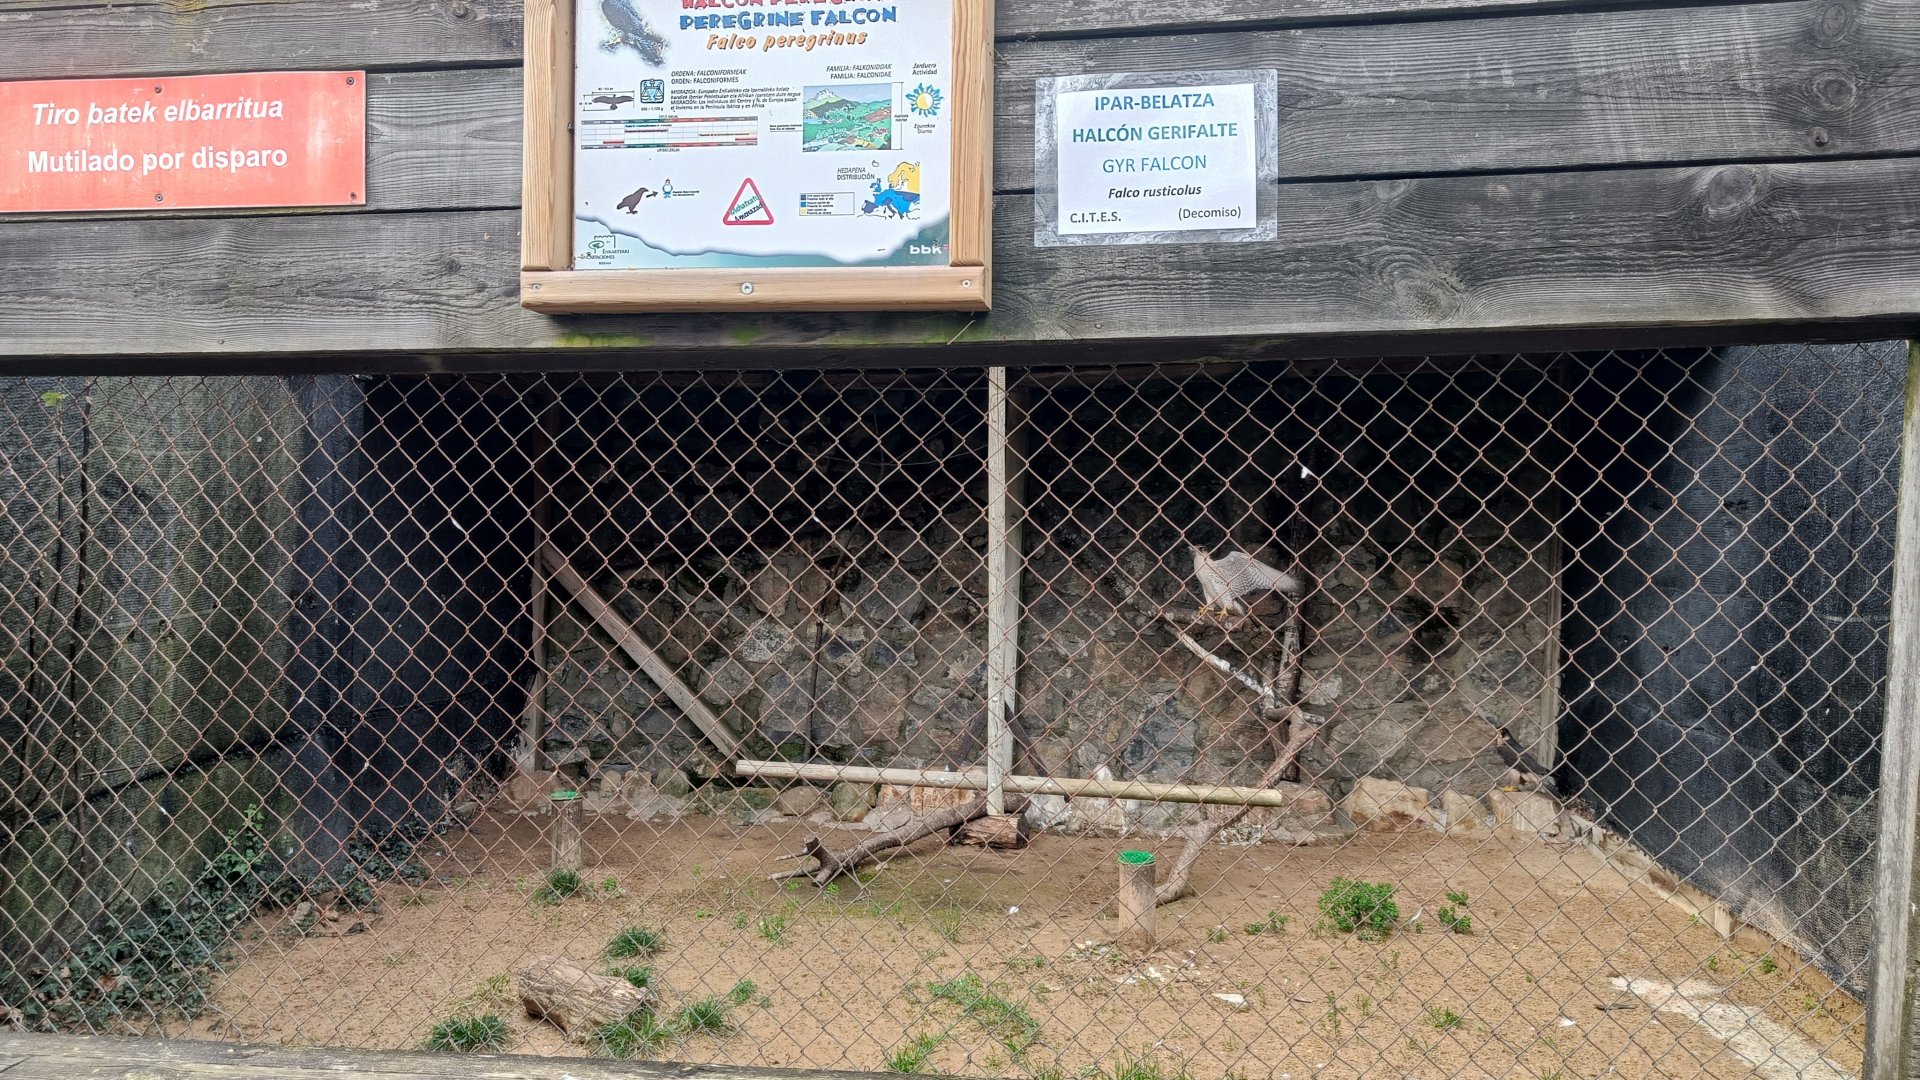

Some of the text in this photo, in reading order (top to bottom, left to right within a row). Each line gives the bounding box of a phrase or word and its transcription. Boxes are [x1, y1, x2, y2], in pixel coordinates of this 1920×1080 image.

[680, 6, 897, 30] PEREGRINE FALCON
[706, 30, 868, 52] Falco peregrinus
[1095, 93, 1215, 111] IPAR-BELATZA
[33, 97, 284, 126] Tiro batek elbarritua
[1073, 123, 1238, 143] HALCÓN GERIFALTE
[28, 147, 287, 175] Mutilado por disparo
[1103, 155, 1207, 173] GYR FALCON
[837, 172, 875, 180] DISTRIBUCIÓN
[1108, 184, 1202, 199] Falco rusticolus
[1070, 206, 1242, 223] C.I.T.E.S. (Decomiso)
[909, 244, 942, 255] bbk
